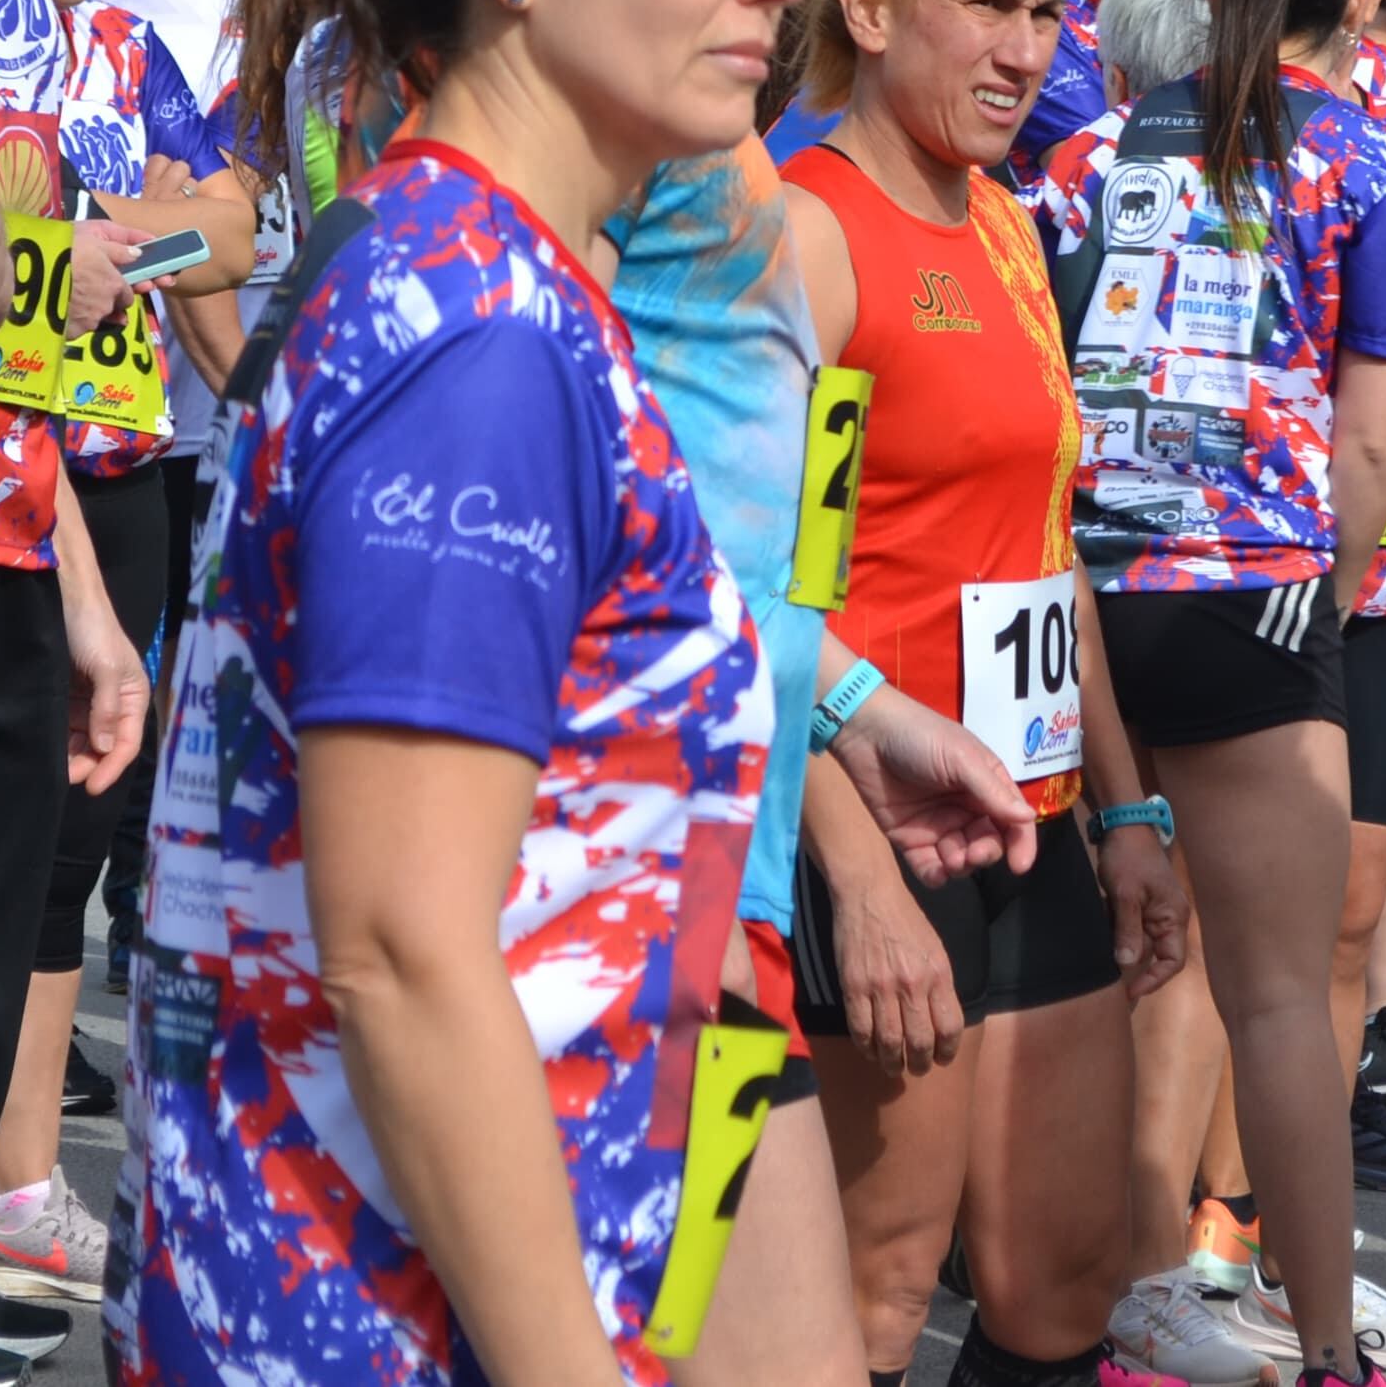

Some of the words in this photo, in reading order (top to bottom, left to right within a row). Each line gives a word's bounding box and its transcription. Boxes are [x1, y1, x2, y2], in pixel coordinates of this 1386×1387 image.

[1176, 299, 1254, 324] maranga
[1184, 274, 1199, 292] la
[1205, 279, 1252, 301] mejor
[821, 399, 869, 513] 2
[371, 471, 435, 526] El
[450, 484, 557, 564] Criollo
